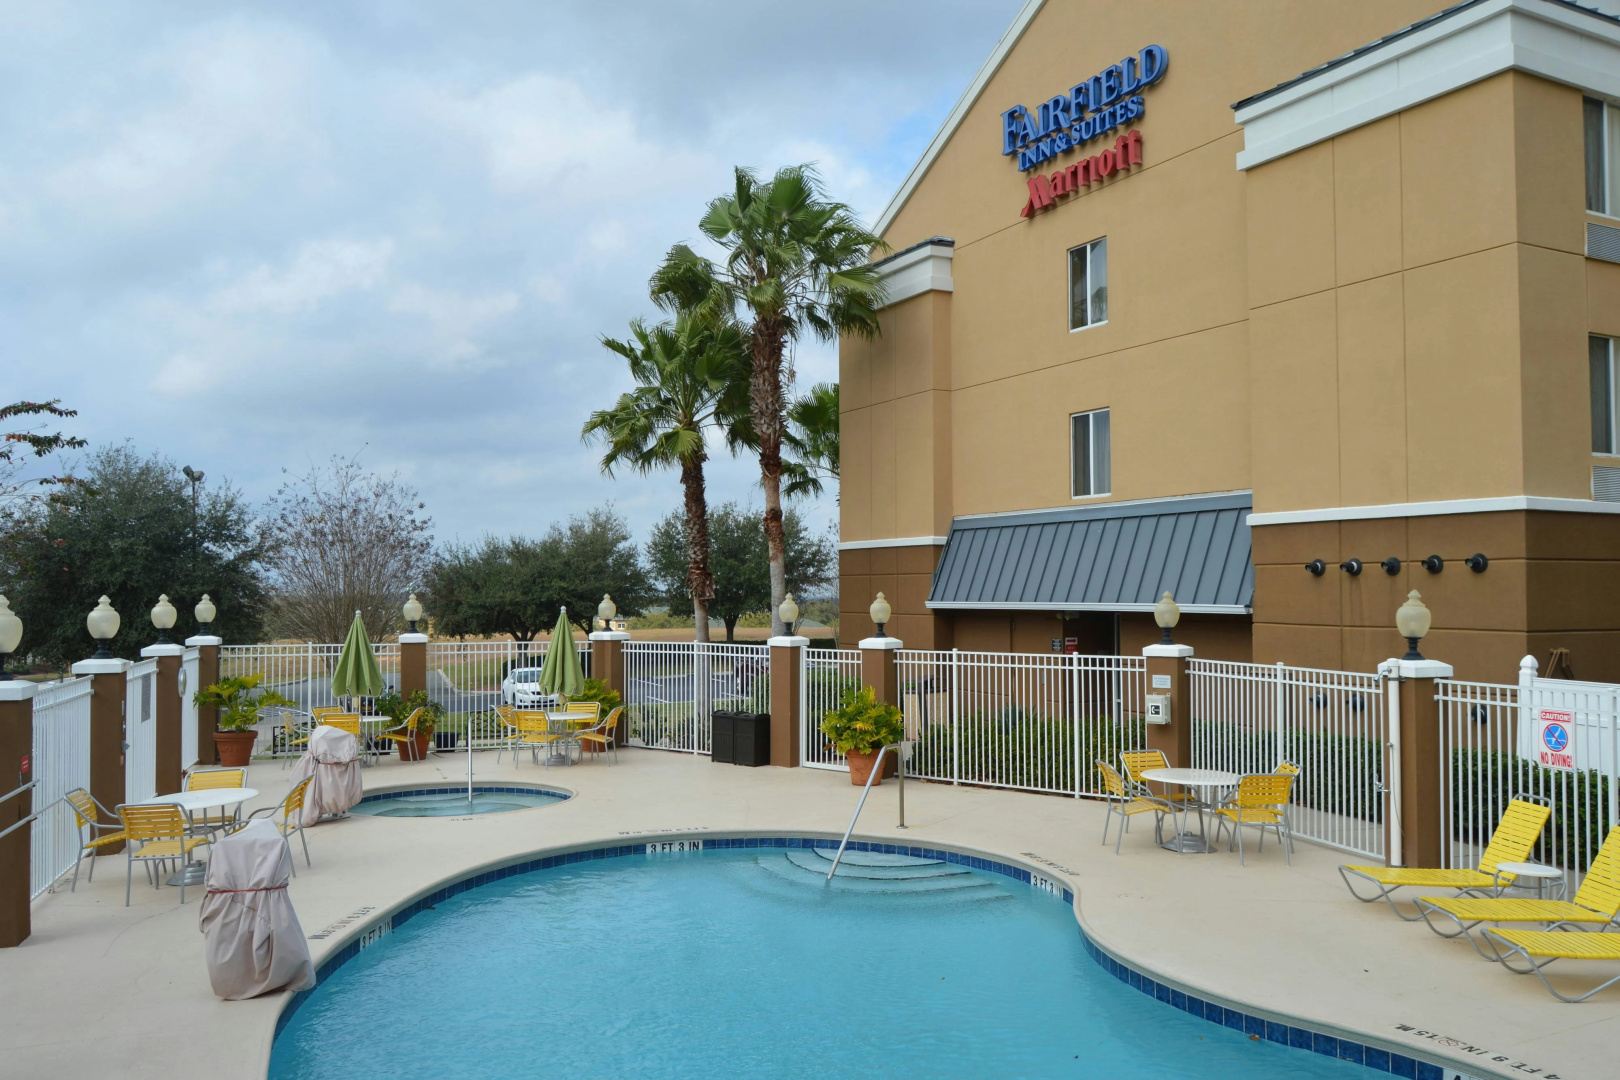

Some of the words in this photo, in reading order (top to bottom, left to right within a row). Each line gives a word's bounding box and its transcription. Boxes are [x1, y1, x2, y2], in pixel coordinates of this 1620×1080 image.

[1000, 44, 1168, 156] FAIRFIELD
[1017, 137, 1057, 172] INN
[1054, 132, 1074, 154] &
[1071, 95, 1145, 146] SUITES
[1020, 129, 1143, 218] Marriott
[1540, 751, 1549, 765] NO
[1550, 753, 1573, 768] DIVING!
[650, 843, 657, 853] 3
[678, 841, 685, 851] 3
[688, 841, 700, 850] IN
[1033, 875, 1038, 886] 3
[1050, 882, 1054, 893] 3
